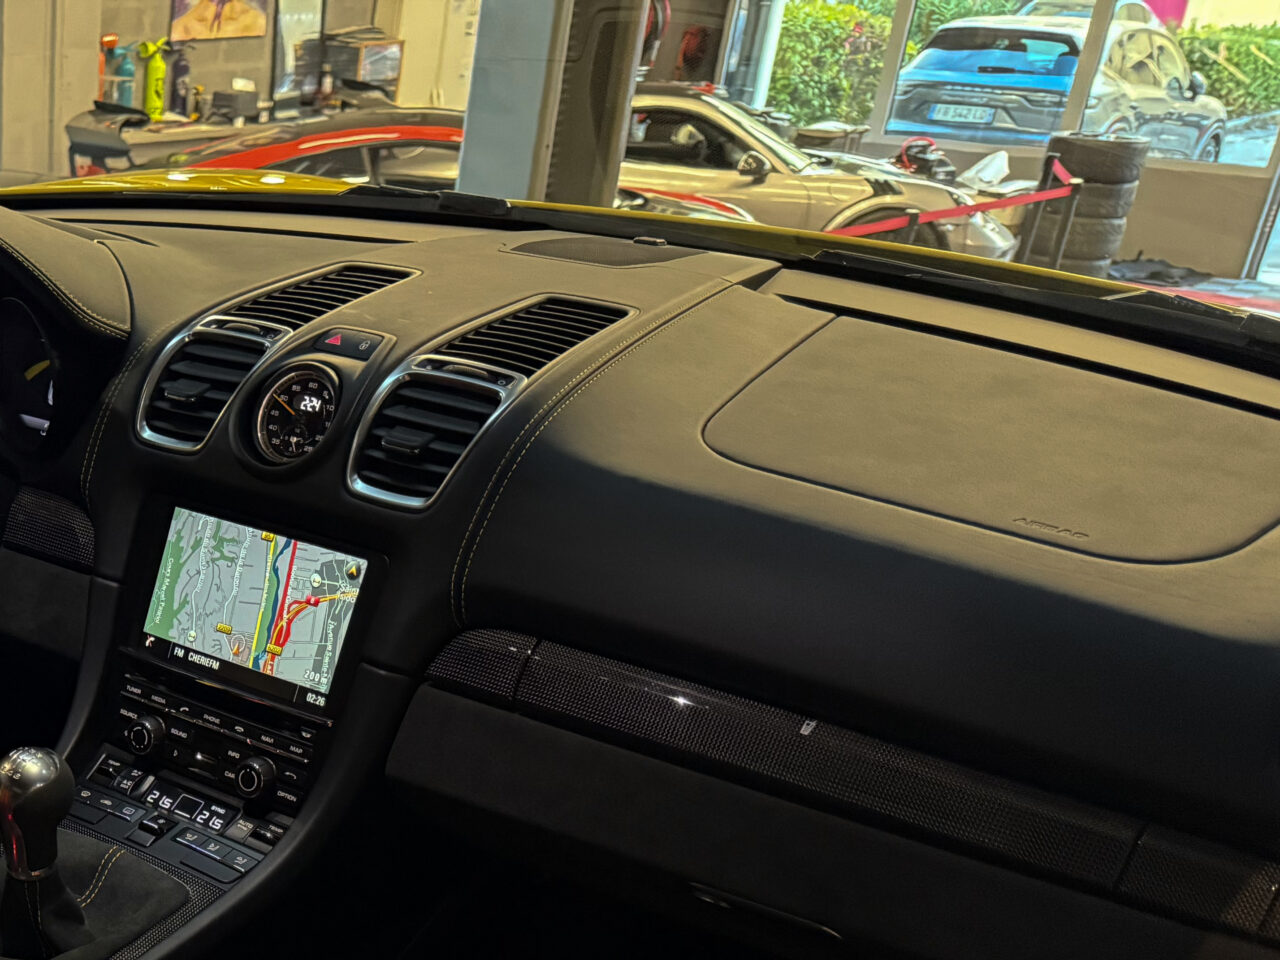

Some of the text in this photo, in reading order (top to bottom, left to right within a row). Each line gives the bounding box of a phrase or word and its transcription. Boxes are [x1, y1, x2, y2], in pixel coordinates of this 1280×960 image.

[173, 646, 185, 659] FM
[304, 669, 320, 682] 200
[305, 692, 326, 707] 02:26
[276, 789, 297, 803] OPTION
